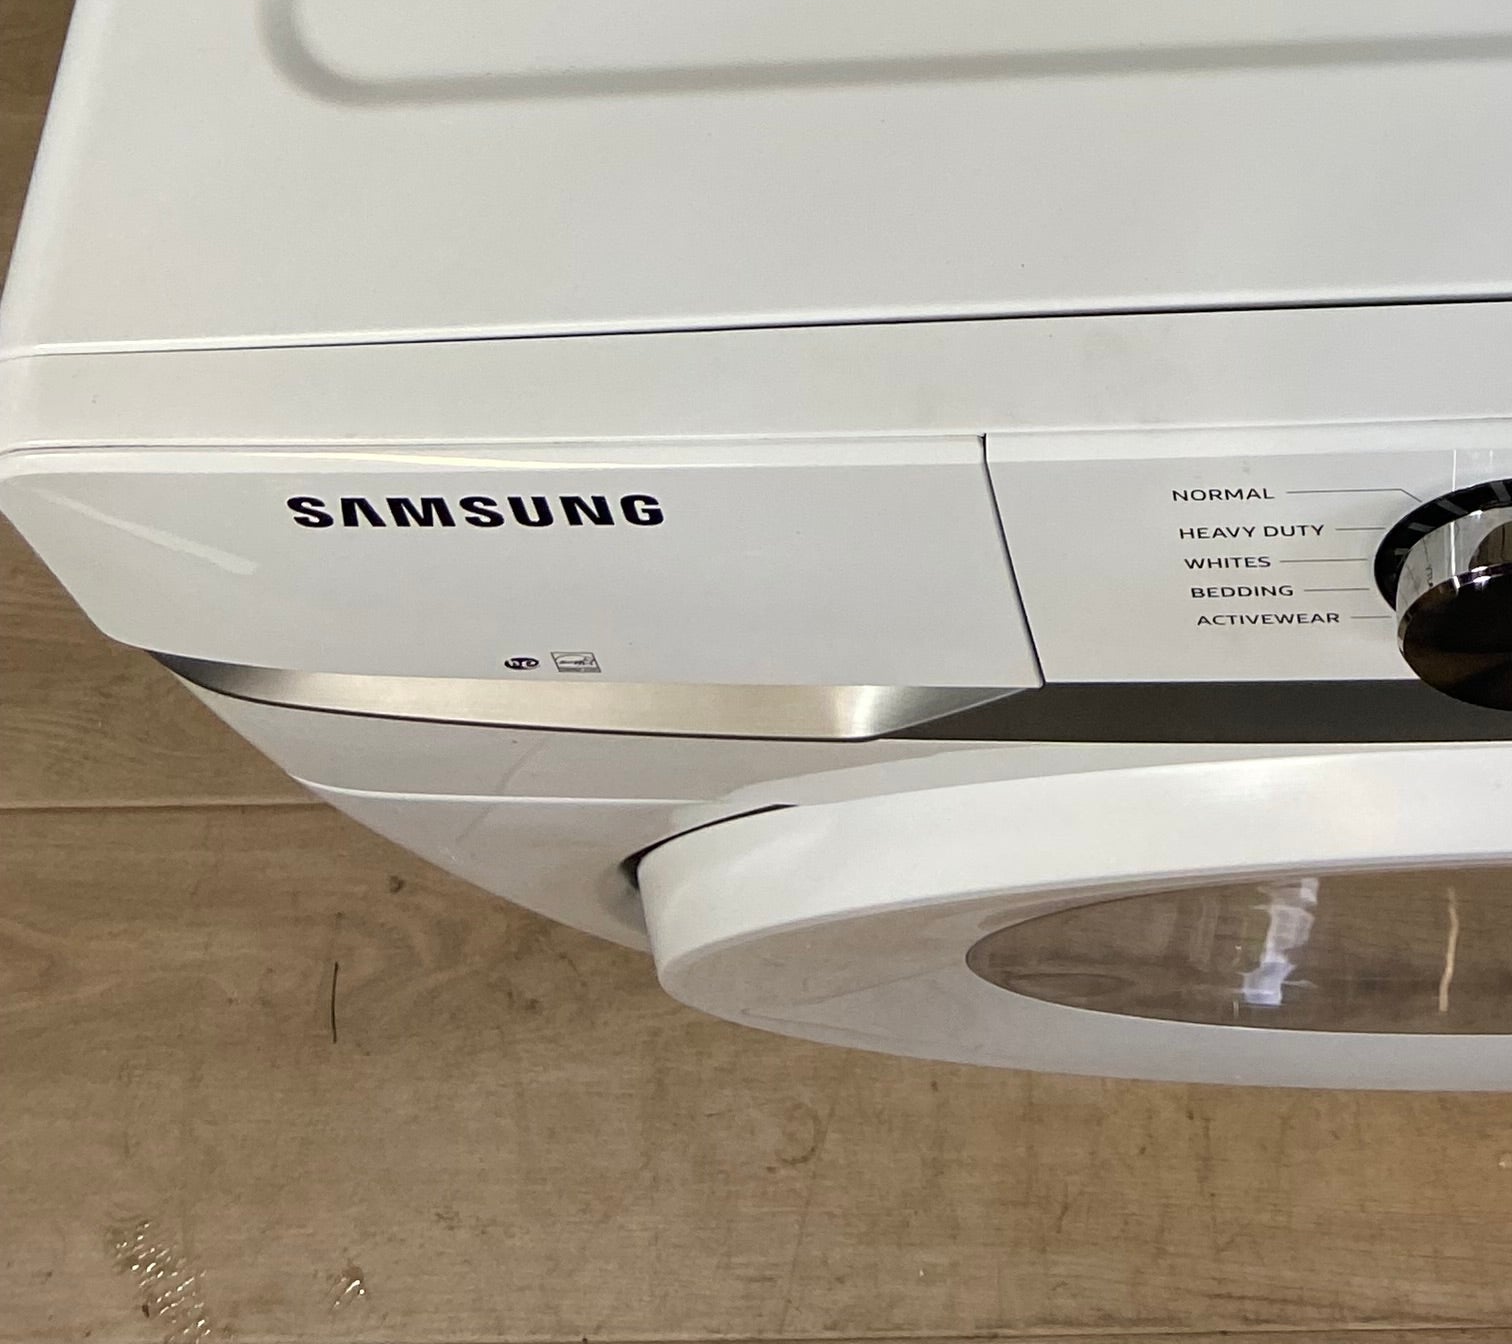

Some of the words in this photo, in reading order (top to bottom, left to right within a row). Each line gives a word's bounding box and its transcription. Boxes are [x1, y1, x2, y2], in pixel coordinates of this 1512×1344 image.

[1172, 488, 1275, 502] NORMAL
[286, 494, 665, 529] SAMSUNG
[1179, 526, 1256, 539] HEAVY
[1264, 524, 1325, 537] DUTY
[1184, 556, 1271, 569] WHITES
[1191, 585, 1294, 598] BEDDING
[1197, 613, 1340, 626] ACTIVEWEAR
